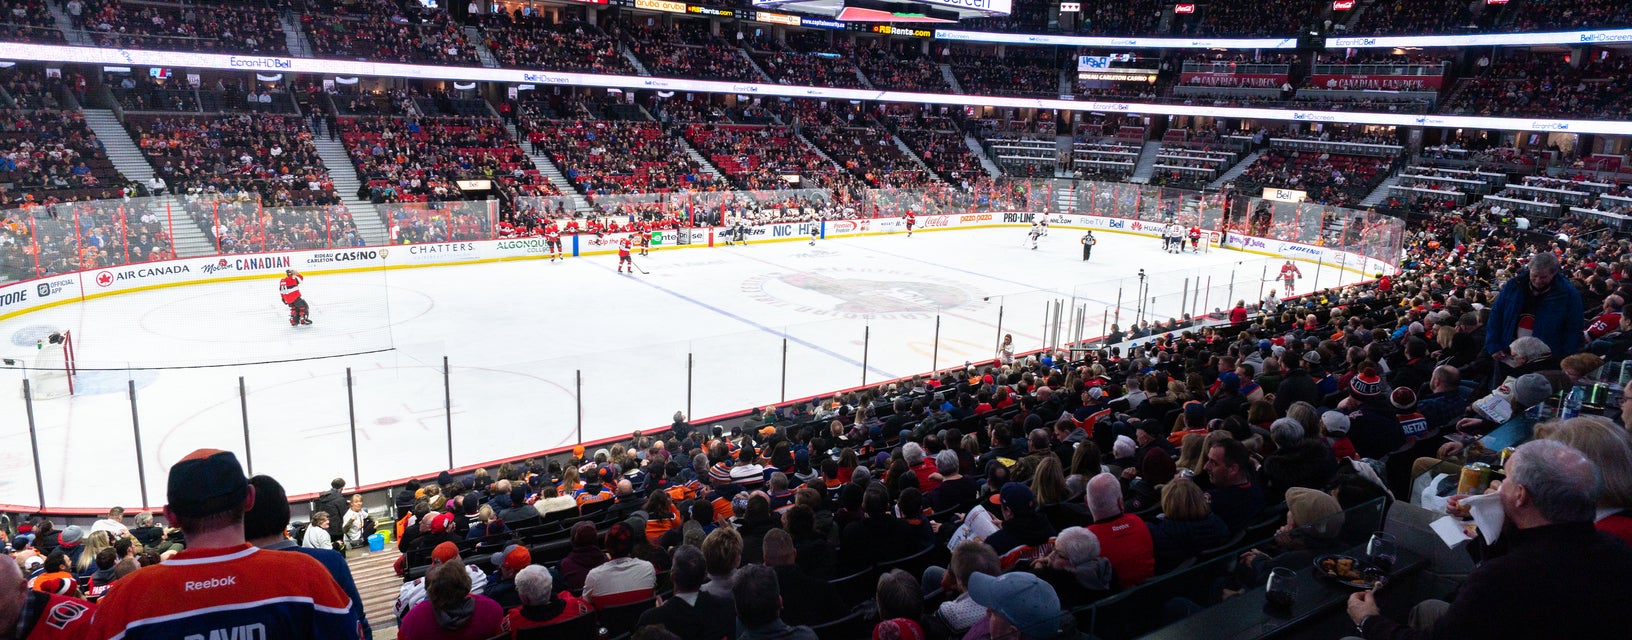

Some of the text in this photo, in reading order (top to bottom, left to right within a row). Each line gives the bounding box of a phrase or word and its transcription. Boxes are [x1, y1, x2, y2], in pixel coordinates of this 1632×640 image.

[663, 2, 685, 10] aruba
[1339, 79, 1424, 89] CANADIAN FAN DECK
[1276, 190, 1293, 200] Bell
[960, 214, 993, 224] pizza pizza
[1109, 218, 1125, 228] Bell
[773, 224, 811, 237] NIC HI
[410, 243, 474, 254] CHATTERS
[236, 256, 291, 271] CANADIAN
[116, 265, 191, 281] AIR CANADA
[50, 279, 75, 288] OFFICIAL
[52, 288, 63, 296] APP
[185, 575, 236, 592] Reebok
